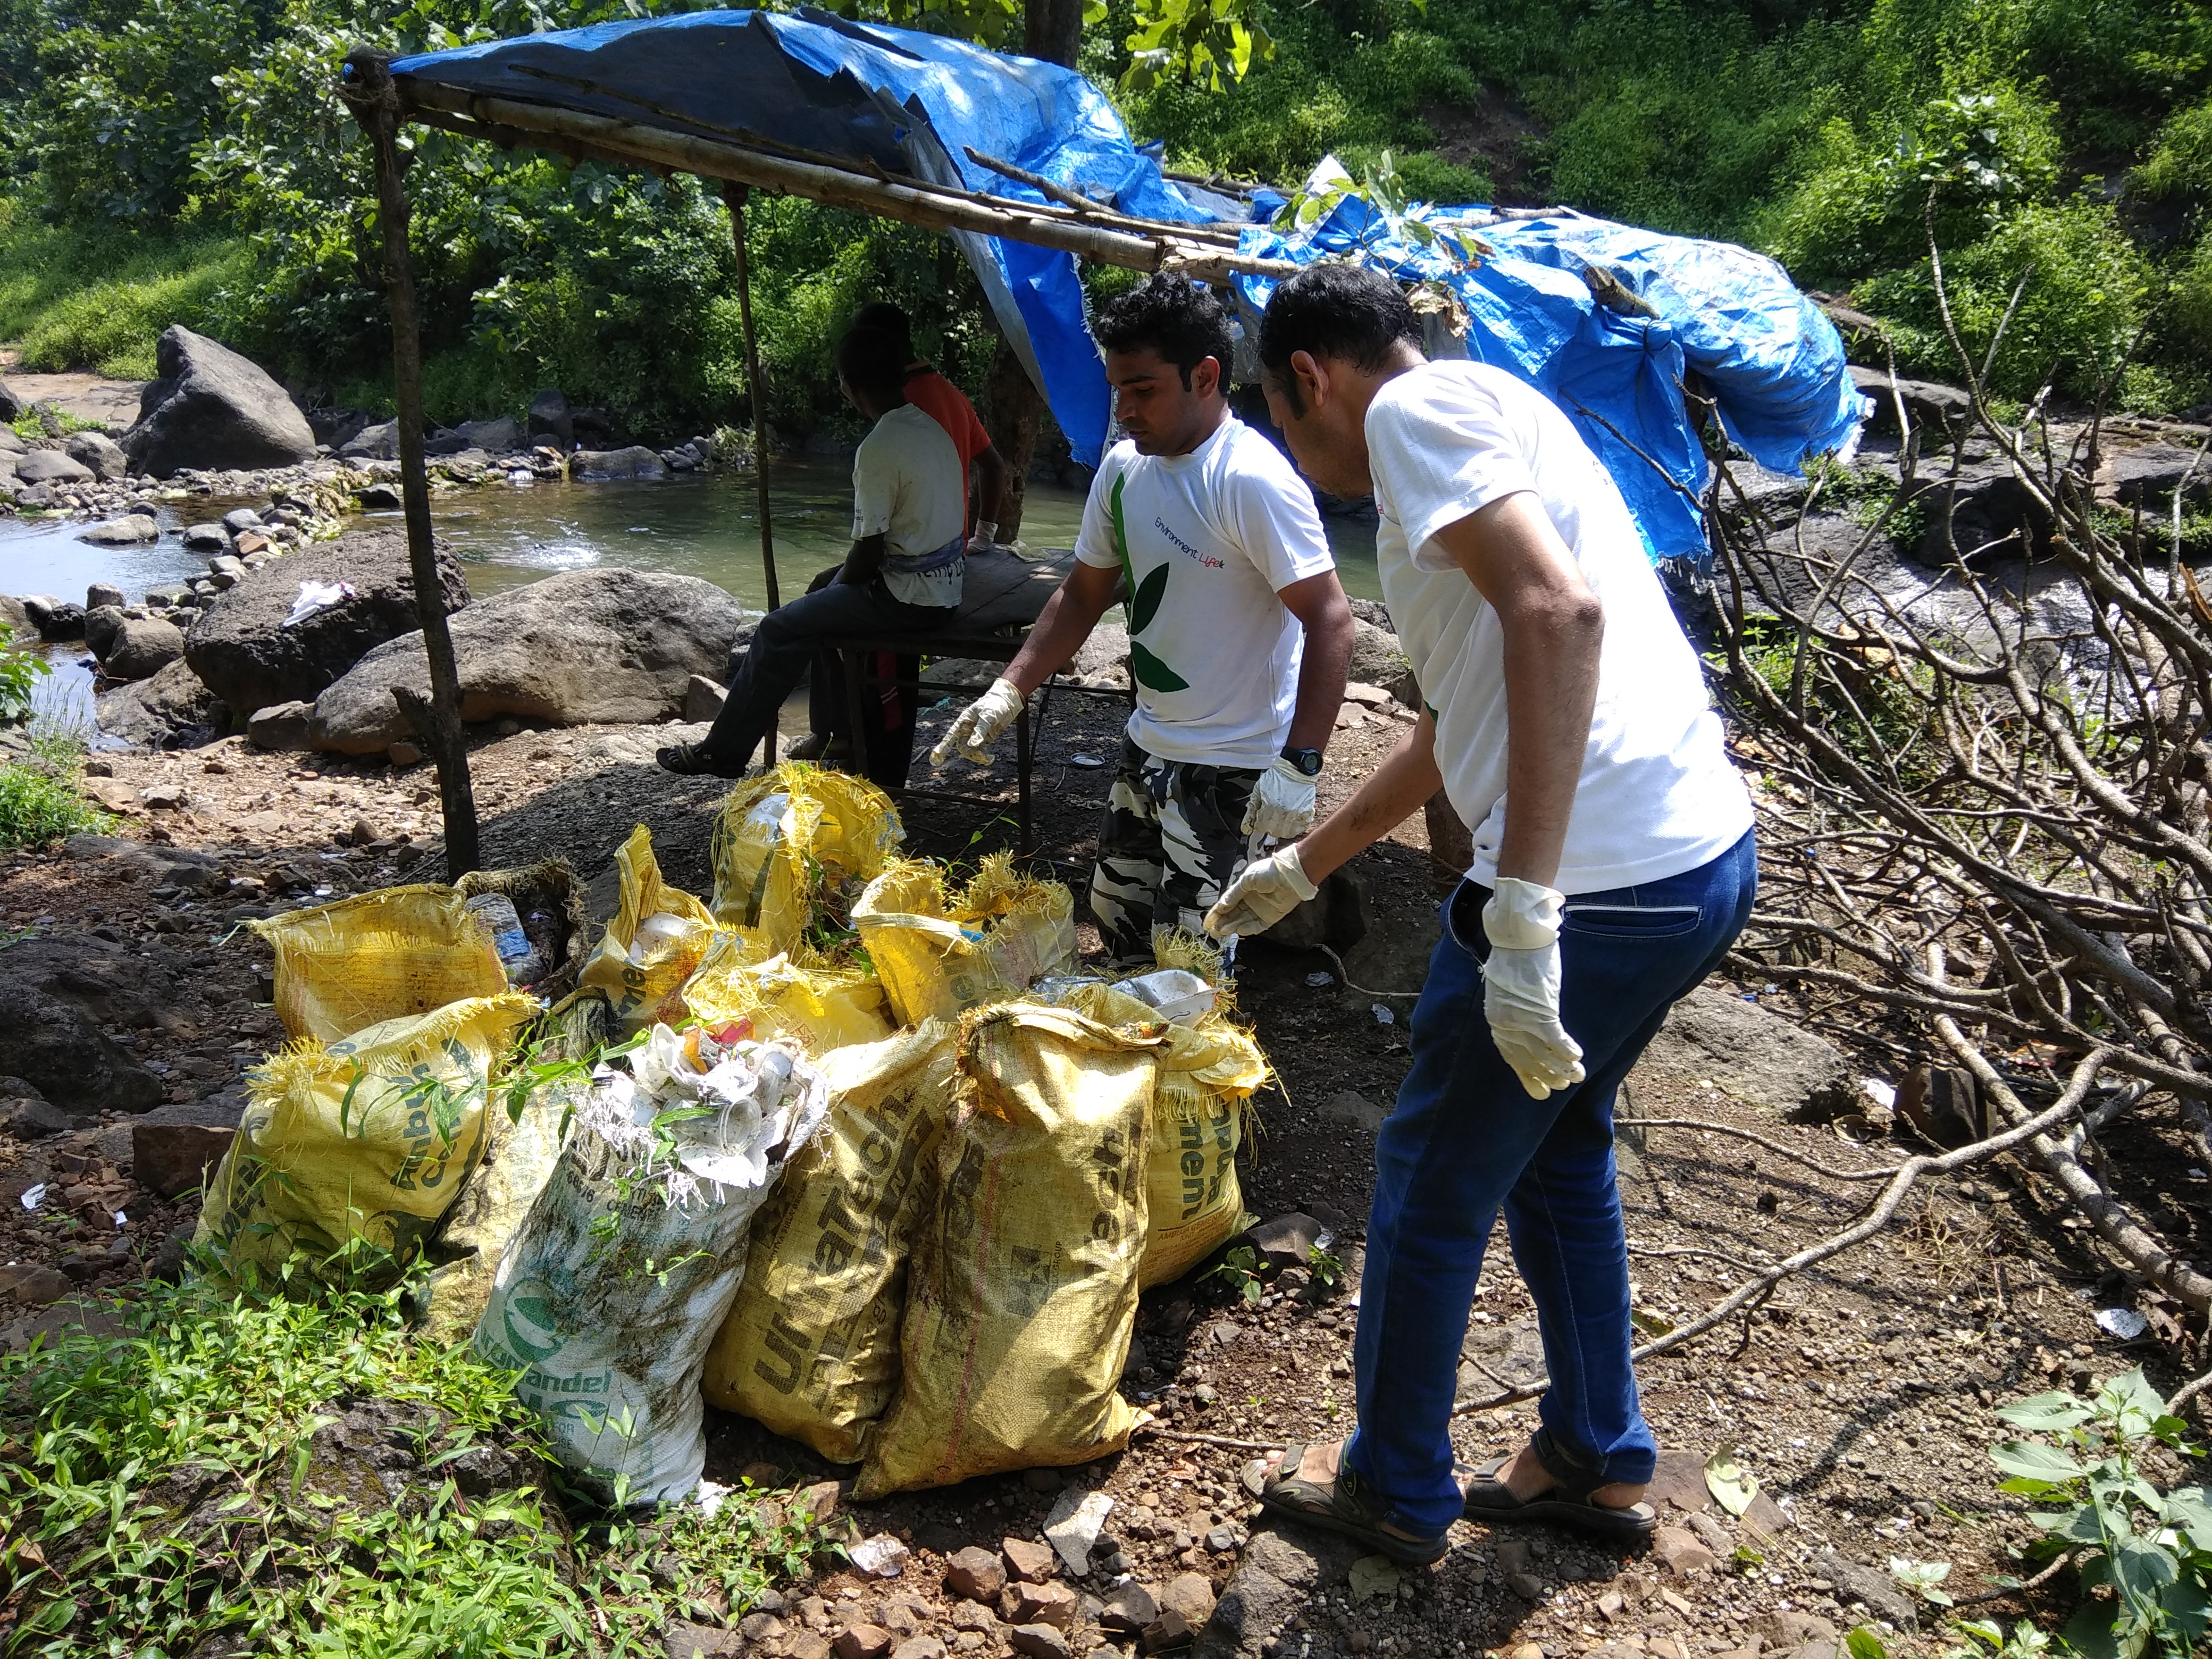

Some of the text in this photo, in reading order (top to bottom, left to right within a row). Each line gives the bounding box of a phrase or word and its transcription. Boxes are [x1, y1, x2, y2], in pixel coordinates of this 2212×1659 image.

[1155, 516, 1220, 567] Environment Life
[753, 1094, 910, 1394] UltraTech
